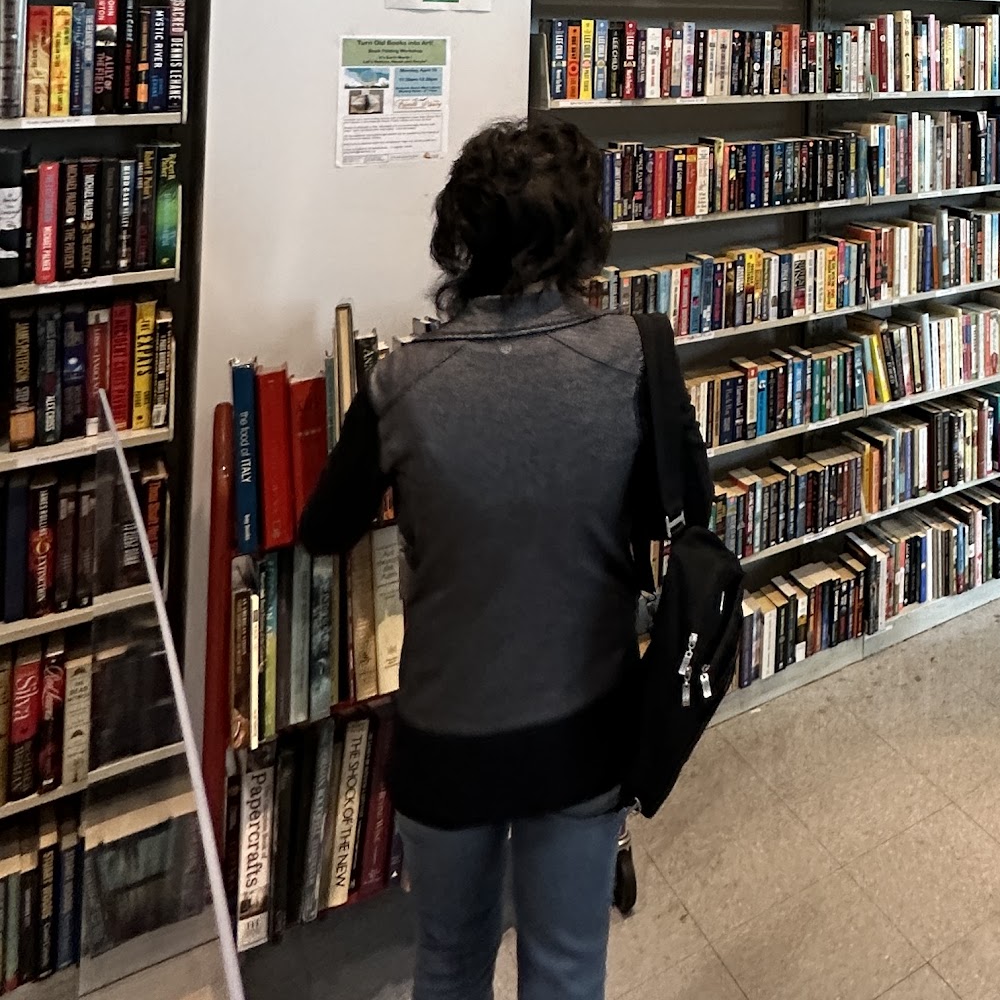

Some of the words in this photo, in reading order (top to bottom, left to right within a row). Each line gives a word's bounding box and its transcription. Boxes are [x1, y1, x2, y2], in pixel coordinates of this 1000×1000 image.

[155, 10, 165, 40] MYSTIC
[171, 2, 186, 32] SACRED
[555, 34, 564, 44] LEE
[584, 34, 592, 43] LEE
[626, 36, 634, 45] LEE
[96, 52, 106, 66] THE
[153, 43, 164, 69] RIVER
[170, 38, 184, 67] DENNIS
[94, 67, 105, 94] FIELD
[105, 61, 115, 79] LILY
[168, 70, 182, 100] LEHANE
[66, 164, 78, 191] MICHAEL
[83, 174, 95, 198] MICHAEL
[65, 192, 78, 216] PALMER
[83, 199, 94, 221] PALMER
[65, 229, 76, 240] THE
[82, 233, 92, 244] THE
[140, 320, 150, 331] THE
[136, 333, 154, 376] EXPATS
[45, 395, 56, 410] ALEX
[45, 411, 55, 432] CROSS
[240, 411, 249, 426] the
[240, 427, 250, 446] food
[241, 458, 252, 483] ITALY
[13, 675, 39, 721] Silva
[350, 735, 363, 757] THE
[343, 760, 359, 809] SHOCK
[341, 808, 354, 827] OF
[245, 772, 267, 889] Papercrafts
[339, 828, 352, 851] THE
[335, 854, 349, 888] NEW
